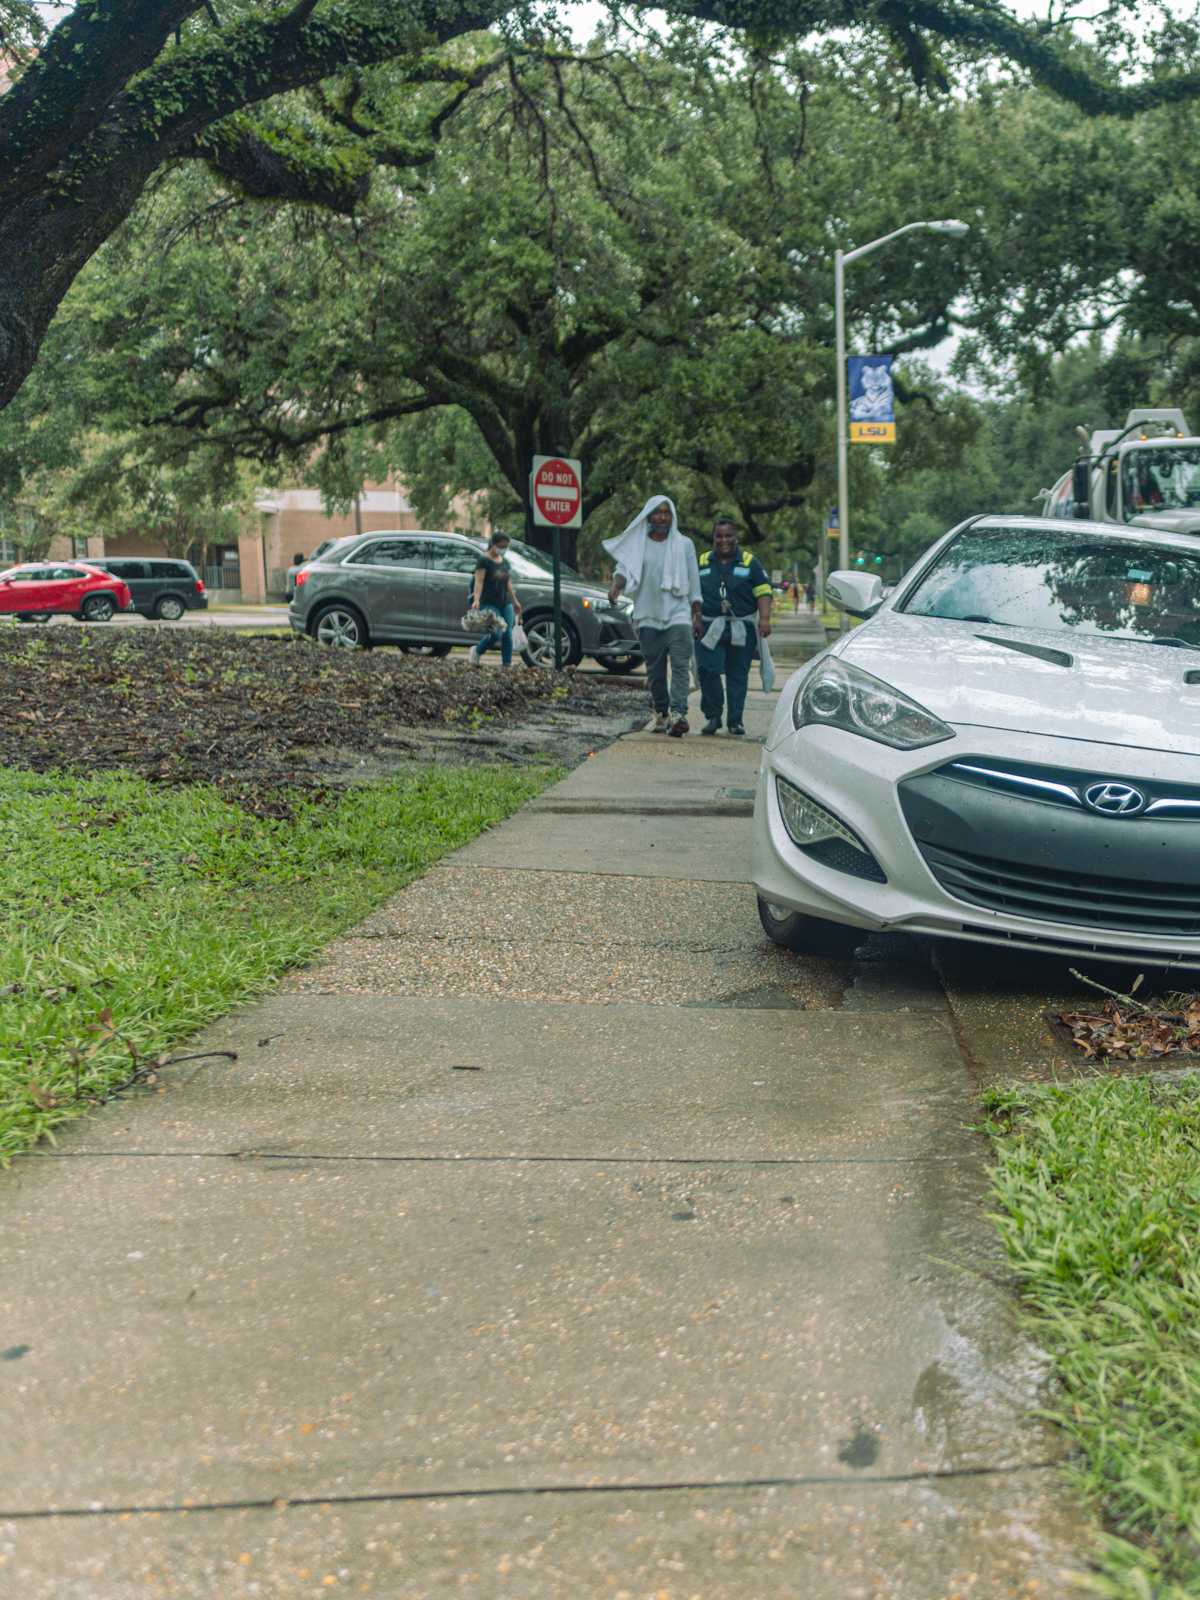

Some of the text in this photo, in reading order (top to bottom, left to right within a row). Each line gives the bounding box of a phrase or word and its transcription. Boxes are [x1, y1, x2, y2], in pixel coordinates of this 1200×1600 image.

[858, 426, 888, 437] LSU
[541, 471, 573, 485] DO NOT
[545, 500, 571, 512] ENTER
